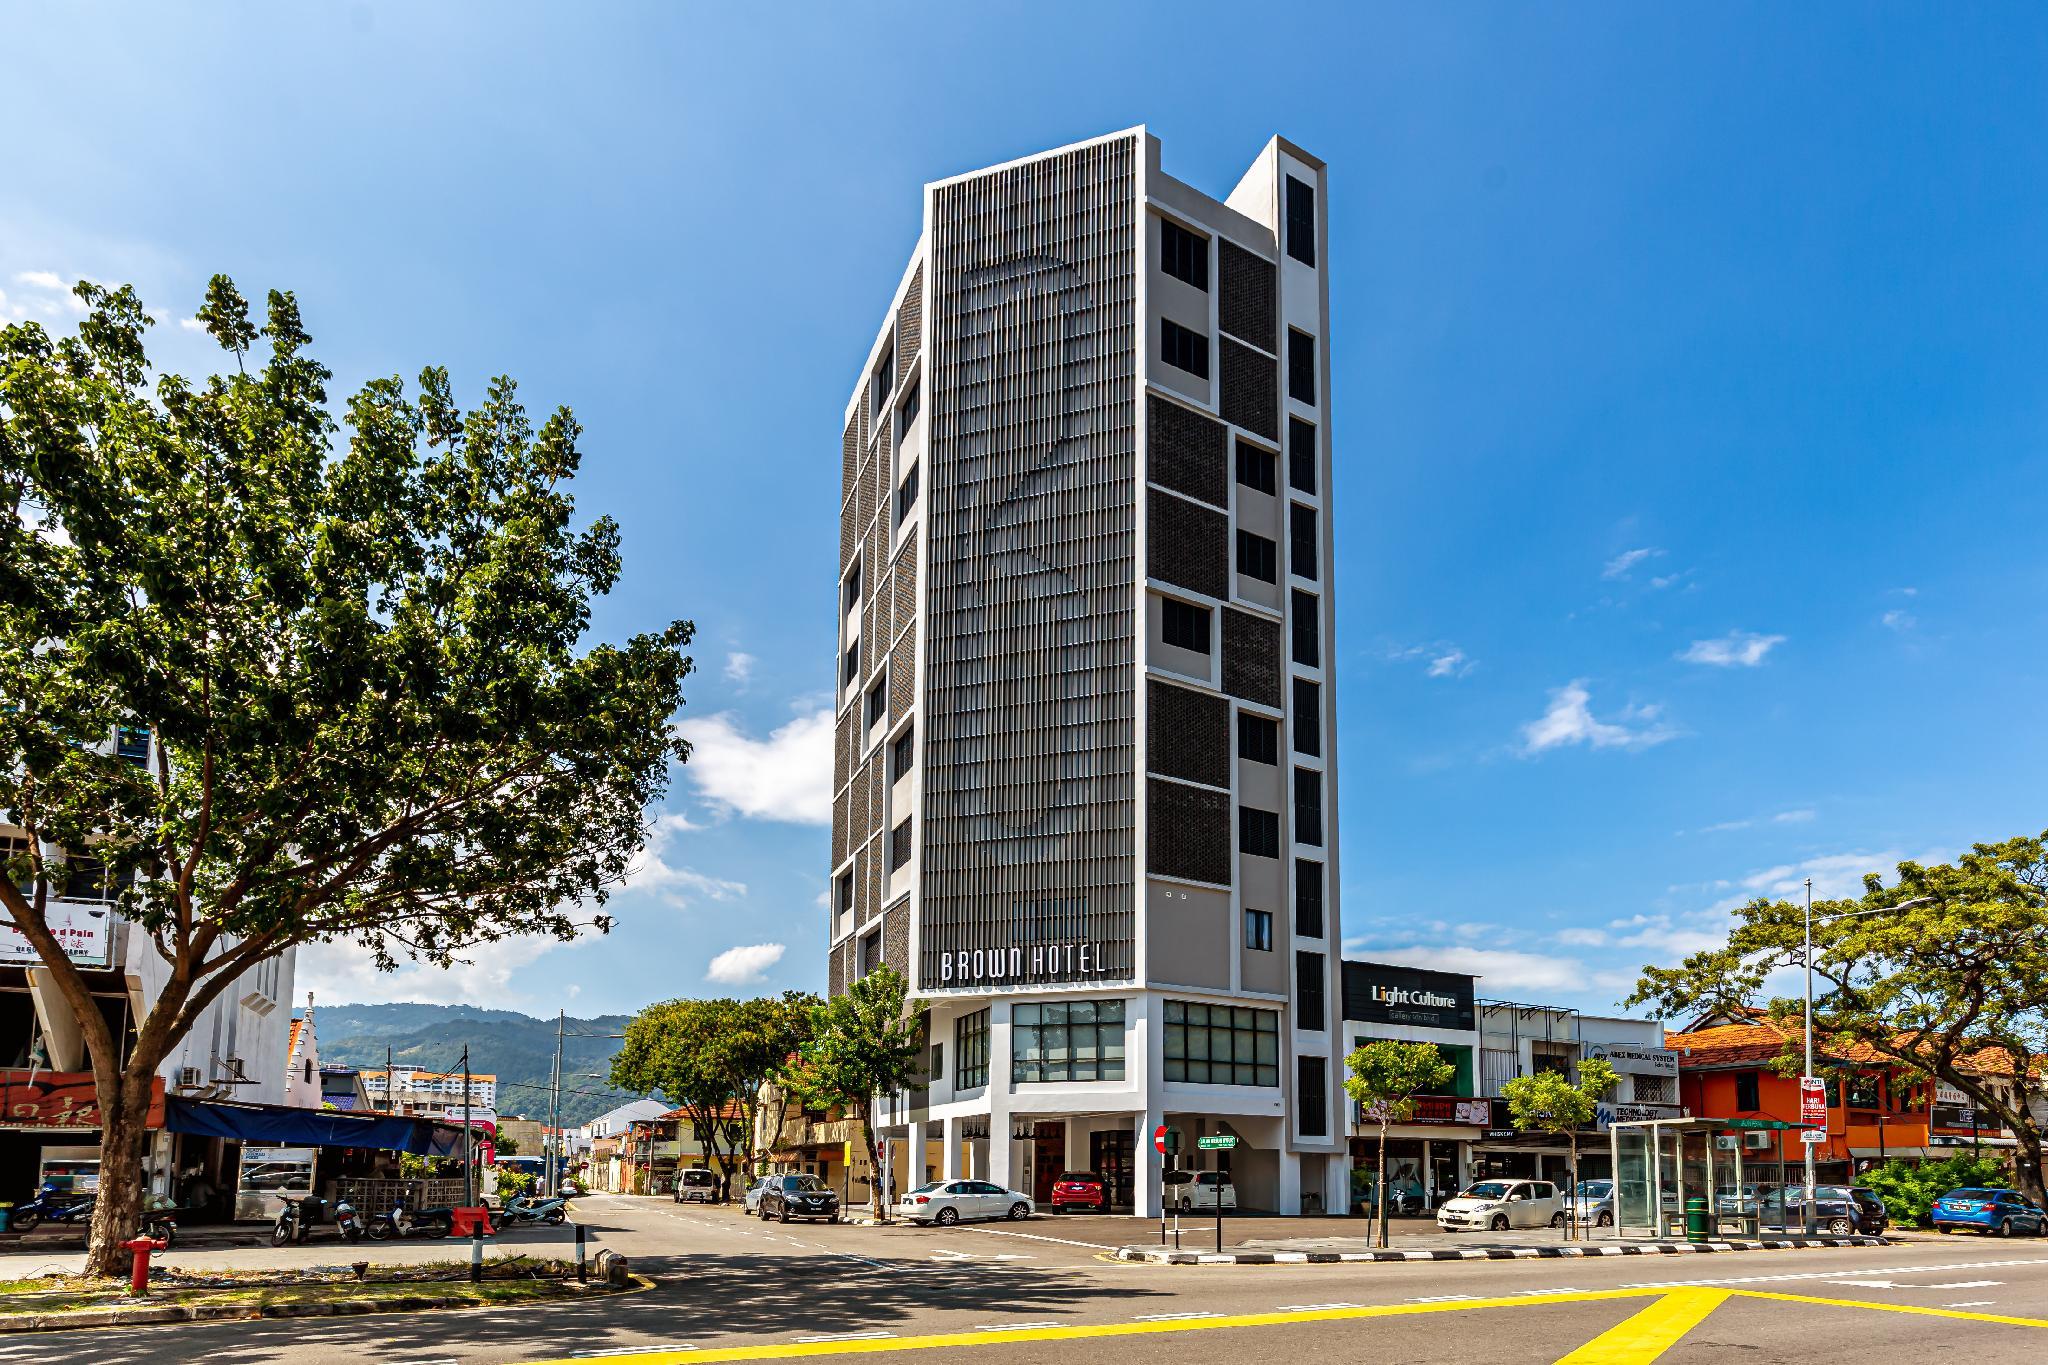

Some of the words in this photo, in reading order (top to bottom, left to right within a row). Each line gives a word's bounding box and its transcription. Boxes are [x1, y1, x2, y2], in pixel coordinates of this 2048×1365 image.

[69, 928, 94, 938] Pain
[941, 947, 1021, 981] BROWN
[1033, 943, 1106, 975] HOTEL
[1371, 985, 1409, 1007] Light
[1410, 990, 1456, 1008] Culture
[1626, 1052, 1651, 1061] MEDICAL
[1652, 1054, 1675, 1063] SYSTEM
